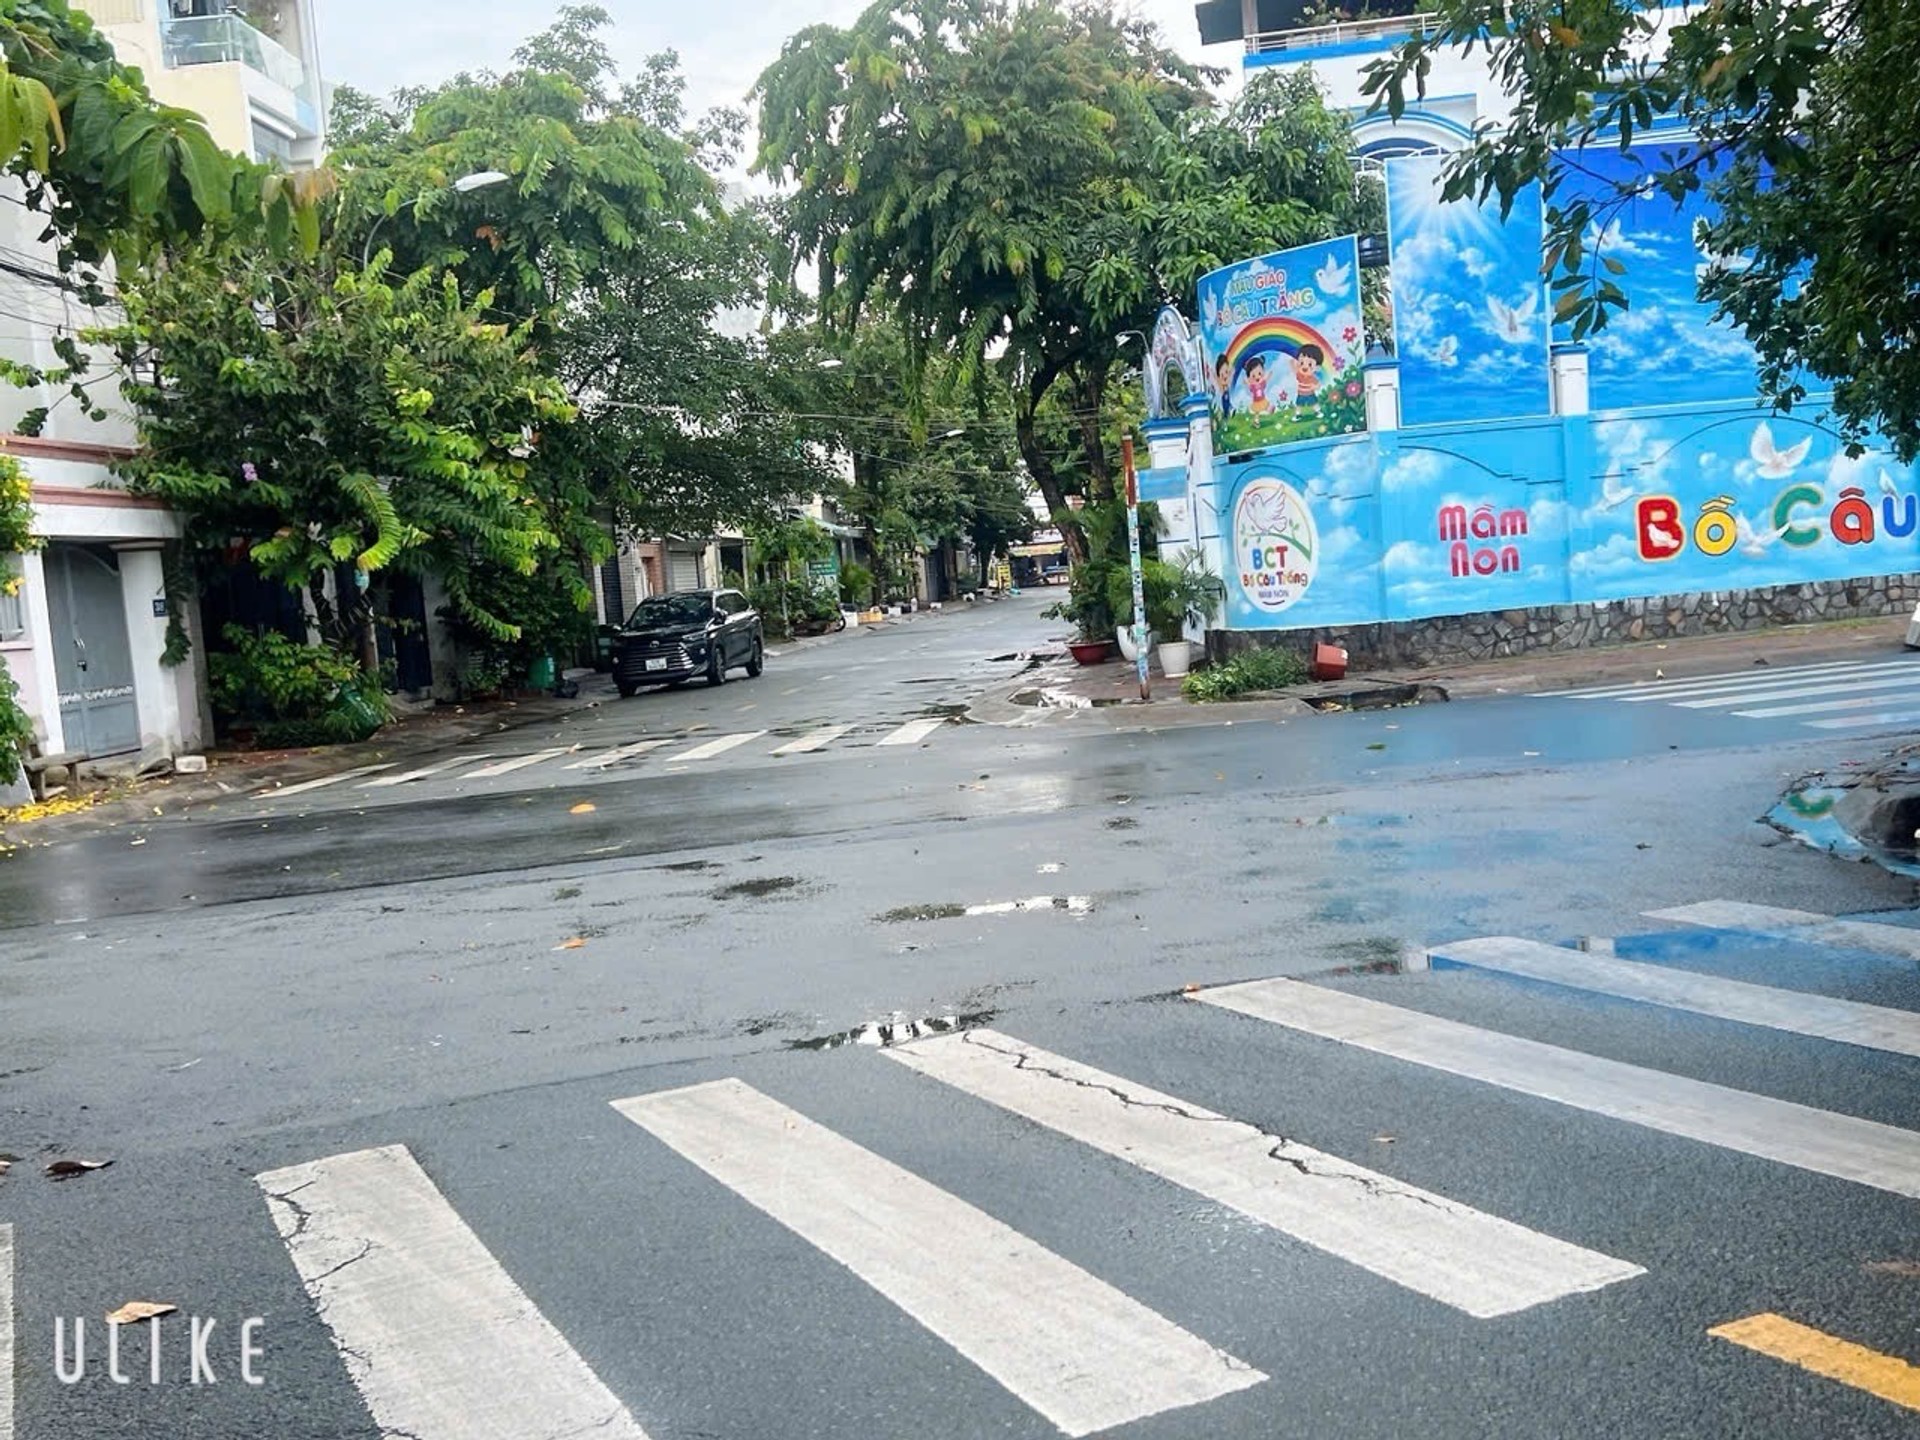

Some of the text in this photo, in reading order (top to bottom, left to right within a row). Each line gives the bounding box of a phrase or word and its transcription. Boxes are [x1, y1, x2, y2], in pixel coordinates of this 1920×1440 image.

[1638, 485, 1916, 561] Bồ Câu
[1252, 545, 1288, 570] BCT
